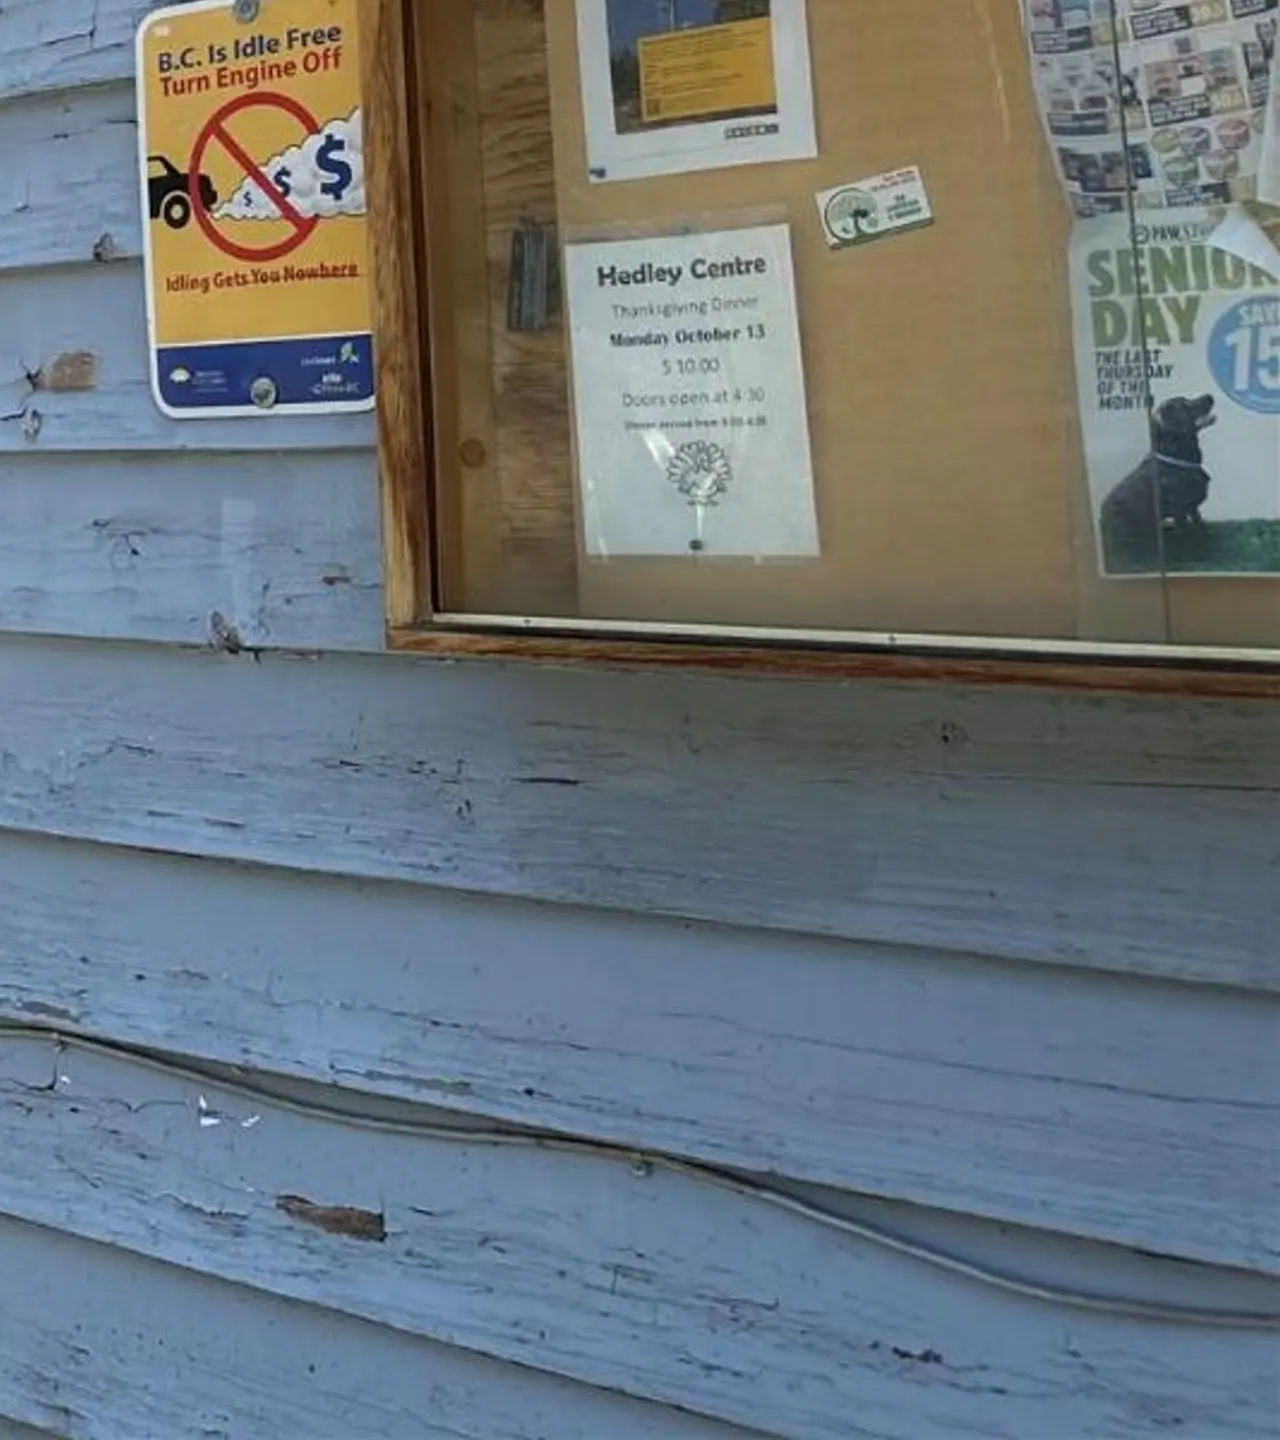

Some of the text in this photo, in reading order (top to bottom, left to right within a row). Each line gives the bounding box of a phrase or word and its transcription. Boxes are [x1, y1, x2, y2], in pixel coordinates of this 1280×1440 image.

[158, 26, 341, 73] B.C. Is Idle Free
[159, 46, 342, 97] Turn Engine Off
[166, 262, 359, 294] Idling Gets You Nowhere
[597, 256, 767, 287] Hedley Centre
[611, 296, 759, 319] Thanksgiving Dinner
[1090, 295, 1202, 347] DAY
[610, 323, 767, 348] Monday October 13
[1096, 364, 1174, 380] THURSDAY
[622, 391, 666, 408] Doors
[668, 391, 710, 408] open
[713, 389, 729, 404] at
[1098, 381, 1115, 395] OF
[1098, 394, 1154, 410] MONTH
